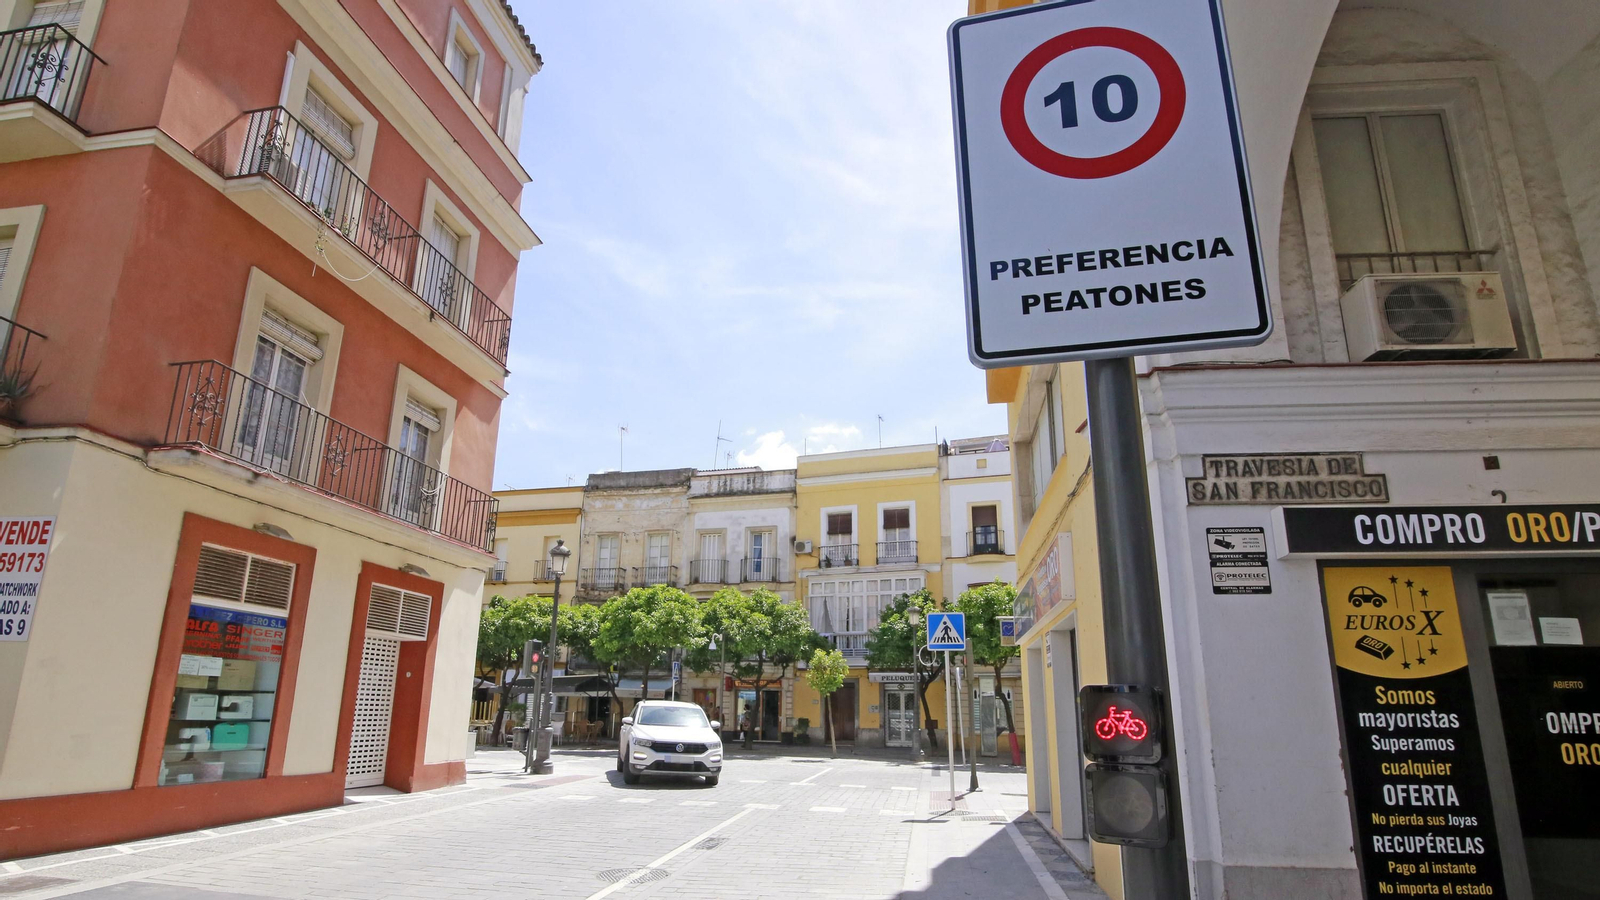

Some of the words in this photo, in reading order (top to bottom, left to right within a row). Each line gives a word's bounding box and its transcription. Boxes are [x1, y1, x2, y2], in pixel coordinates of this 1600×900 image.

[1044, 74, 1139, 129] 10
[990, 237, 1234, 281] PREFERENCIA
[1021, 278, 1207, 315] PEATONES
[1209, 458, 1319, 478] TRAVESIA
[1326, 457, 1358, 476] DE
[1192, 482, 1239, 501] SAN
[1251, 480, 1384, 500] FRANCISCO
[1354, 512, 1486, 545] COMPRO
[0, 552, 46, 573] 59173
[1046, 546, 1058, 582] ORO
[0, 600, 20, 615] ADO
[20, 600, 31, 615] A:
[16, 618, 26, 636] 9
[226, 624, 283, 639] SINGER
[1362, 636, 1384, 650] ORO
[1552, 680, 1584, 690] ABIERTO
[1375, 686, 1436, 705] Somos
[1359, 710, 1460, 732] mayoristas
[1371, 734, 1456, 754] Superamos
[1382, 760, 1452, 778] cualquier
[1383, 784, 1460, 806] OFERTA
[1372, 813, 1386, 825] No
[1390, 814, 1424, 827] pierda
[1427, 816, 1446, 826] sus
[1448, 814, 1478, 828] Joyas
[1373, 832, 1485, 854] RECUPÉRELAS
[1388, 861, 1416, 876] Pago
[1420, 861, 1430, 874] al
[1432, 861, 1477, 874] instante
[1379, 882, 1393, 894] No
[1396, 882, 1438, 896] importa
[1443, 883, 1453, 895] el
[1456, 884, 1493, 896] estado
